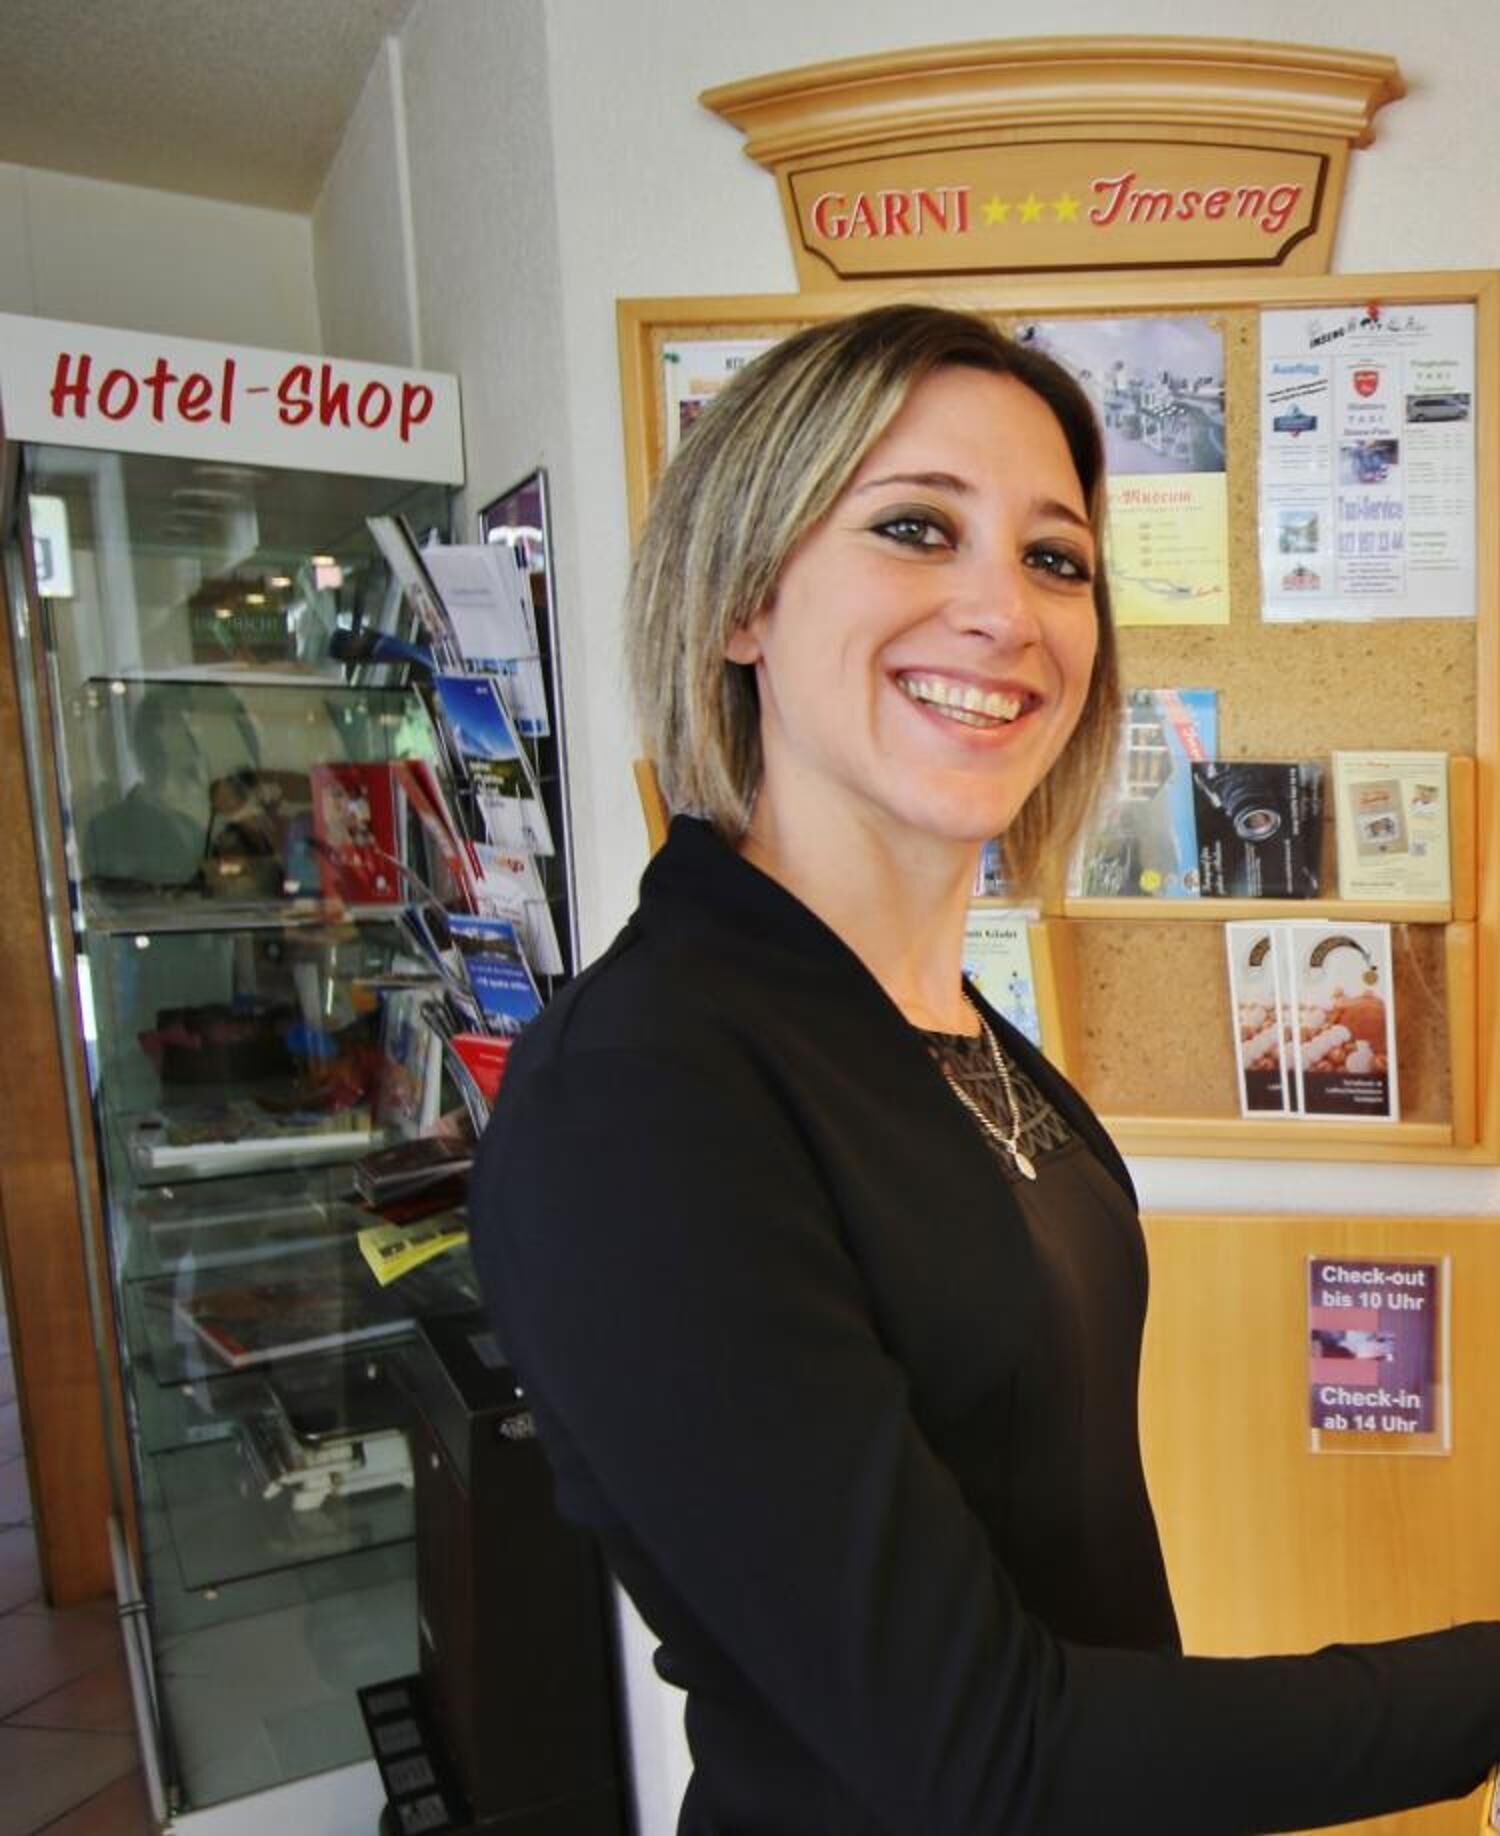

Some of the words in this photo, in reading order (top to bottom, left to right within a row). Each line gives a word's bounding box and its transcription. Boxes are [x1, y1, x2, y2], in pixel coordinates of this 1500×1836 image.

[813, 184, 972, 241] GARNI
[50, 353, 434, 442] Hotel-Shop
[1321, 1265, 1425, 1287] Check-out
[1321, 1291, 1353, 1308] bis
[1359, 1292, 1382, 1309] 10
[1387, 1293, 1425, 1311] Uhr
[1320, 1386, 1421, 1409] Check-in
[1323, 1413, 1348, 1430] ab
[1354, 1415, 1376, 1430] 14
[1382, 1416, 1418, 1432] Uhr
